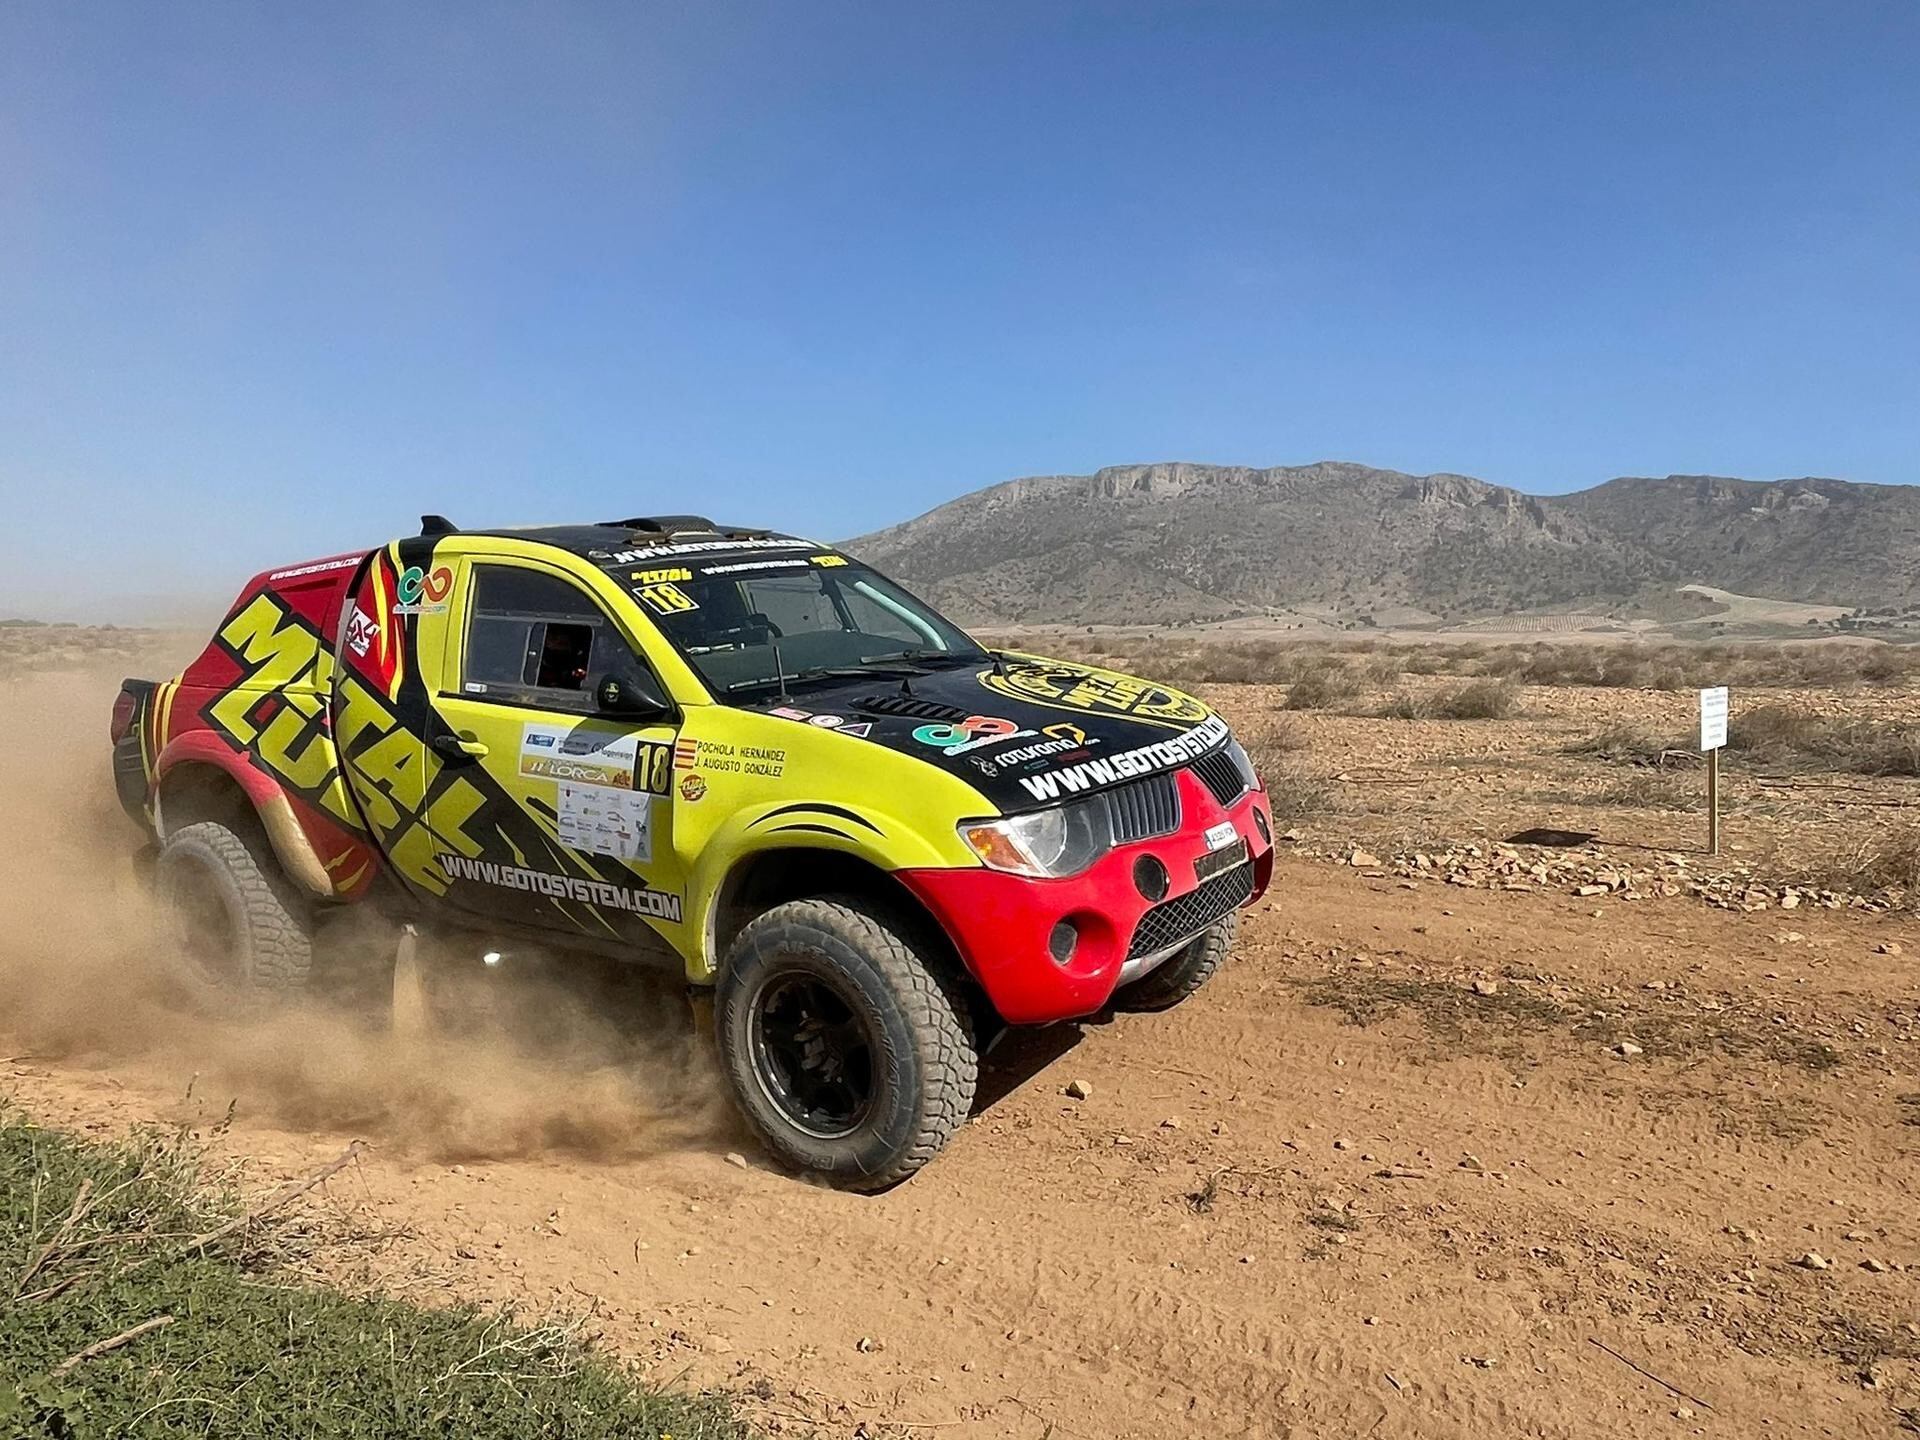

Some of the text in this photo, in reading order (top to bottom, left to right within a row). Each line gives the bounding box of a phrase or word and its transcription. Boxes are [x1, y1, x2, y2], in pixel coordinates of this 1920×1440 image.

[642, 585, 691, 611] 18
[221, 593, 487, 857] METAL
[695, 757, 701, 768] J.
[703, 758, 740, 772] AUGUSTO
[697, 741, 735, 756] POCHOLA
[550, 764, 608, 782] LORCA
[638, 744, 669, 793] 18
[210, 688, 456, 897] LUBE
[440, 854, 682, 922] WWW.GOTOSYSTEM.COM
